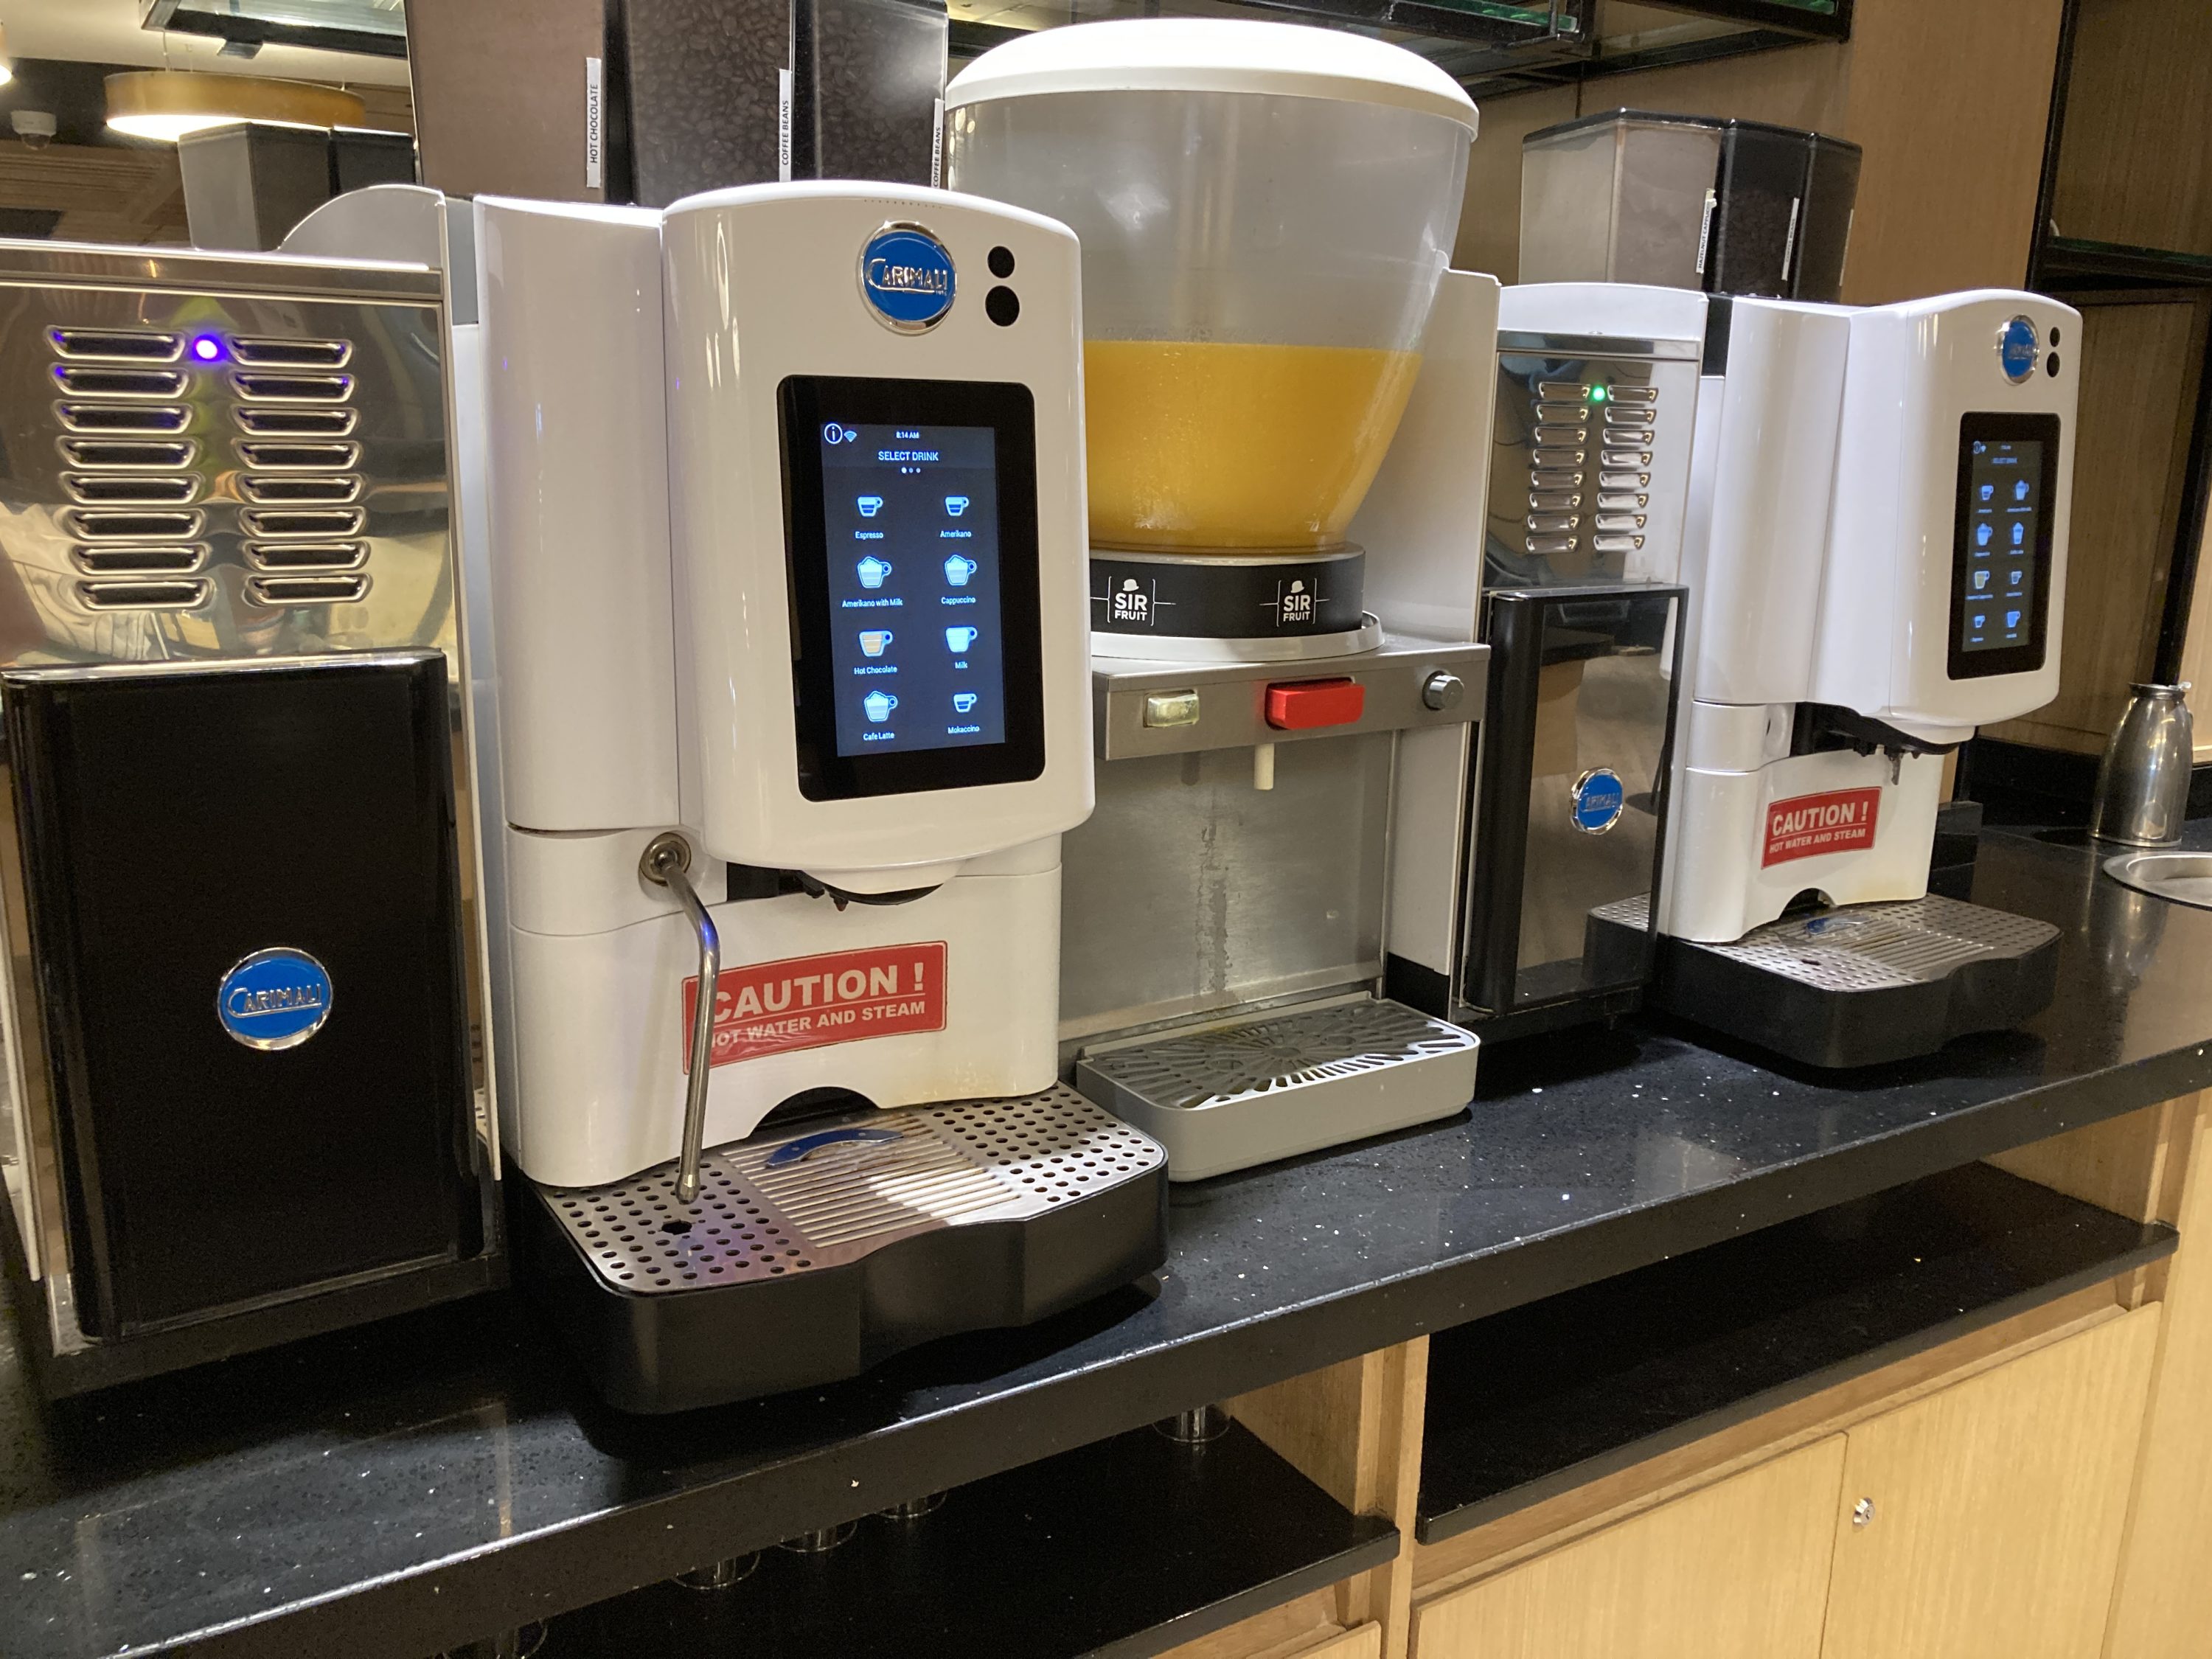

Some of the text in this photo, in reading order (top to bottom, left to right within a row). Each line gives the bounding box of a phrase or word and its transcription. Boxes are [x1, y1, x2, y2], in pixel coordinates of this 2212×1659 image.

[590, 84, 598, 164] HOT CHOCOLATE
[1698, 236, 1706, 268] HAZELNUT
[866, 258, 947, 292] CARIMALI
[896, 431, 908, 439] 8:14
[877, 451, 939, 461] SELECT DRINK
[855, 531, 883, 540] Espresso
[939, 530, 972, 538] Amerikano
[841, 598, 903, 608] Amerikano with Milk
[941, 596, 976, 605] Cappuccino
[1114, 592, 1147, 611] SIR
[1283, 594, 1311, 612] SIR
[1114, 610, 1147, 621] FRUIT
[1283, 611, 1311, 622] FRUIT
[854, 665, 898, 675] Hot Chocolate
[955, 661, 968, 669] Milk
[947, 724, 980, 734] Mokaccino
[863, 731, 894, 741] Cafe Latte
[1772, 801, 1869, 837] CAUTION !
[1769, 828, 1866, 854] HOT WATER AND STEAM
[914, 961, 925, 992] !
[228, 983, 322, 1018] CARIMALI
[746, 1016, 811, 1041] WATER
[817, 1009, 856, 1028] AND
[861, 1001, 925, 1021] STEAM
